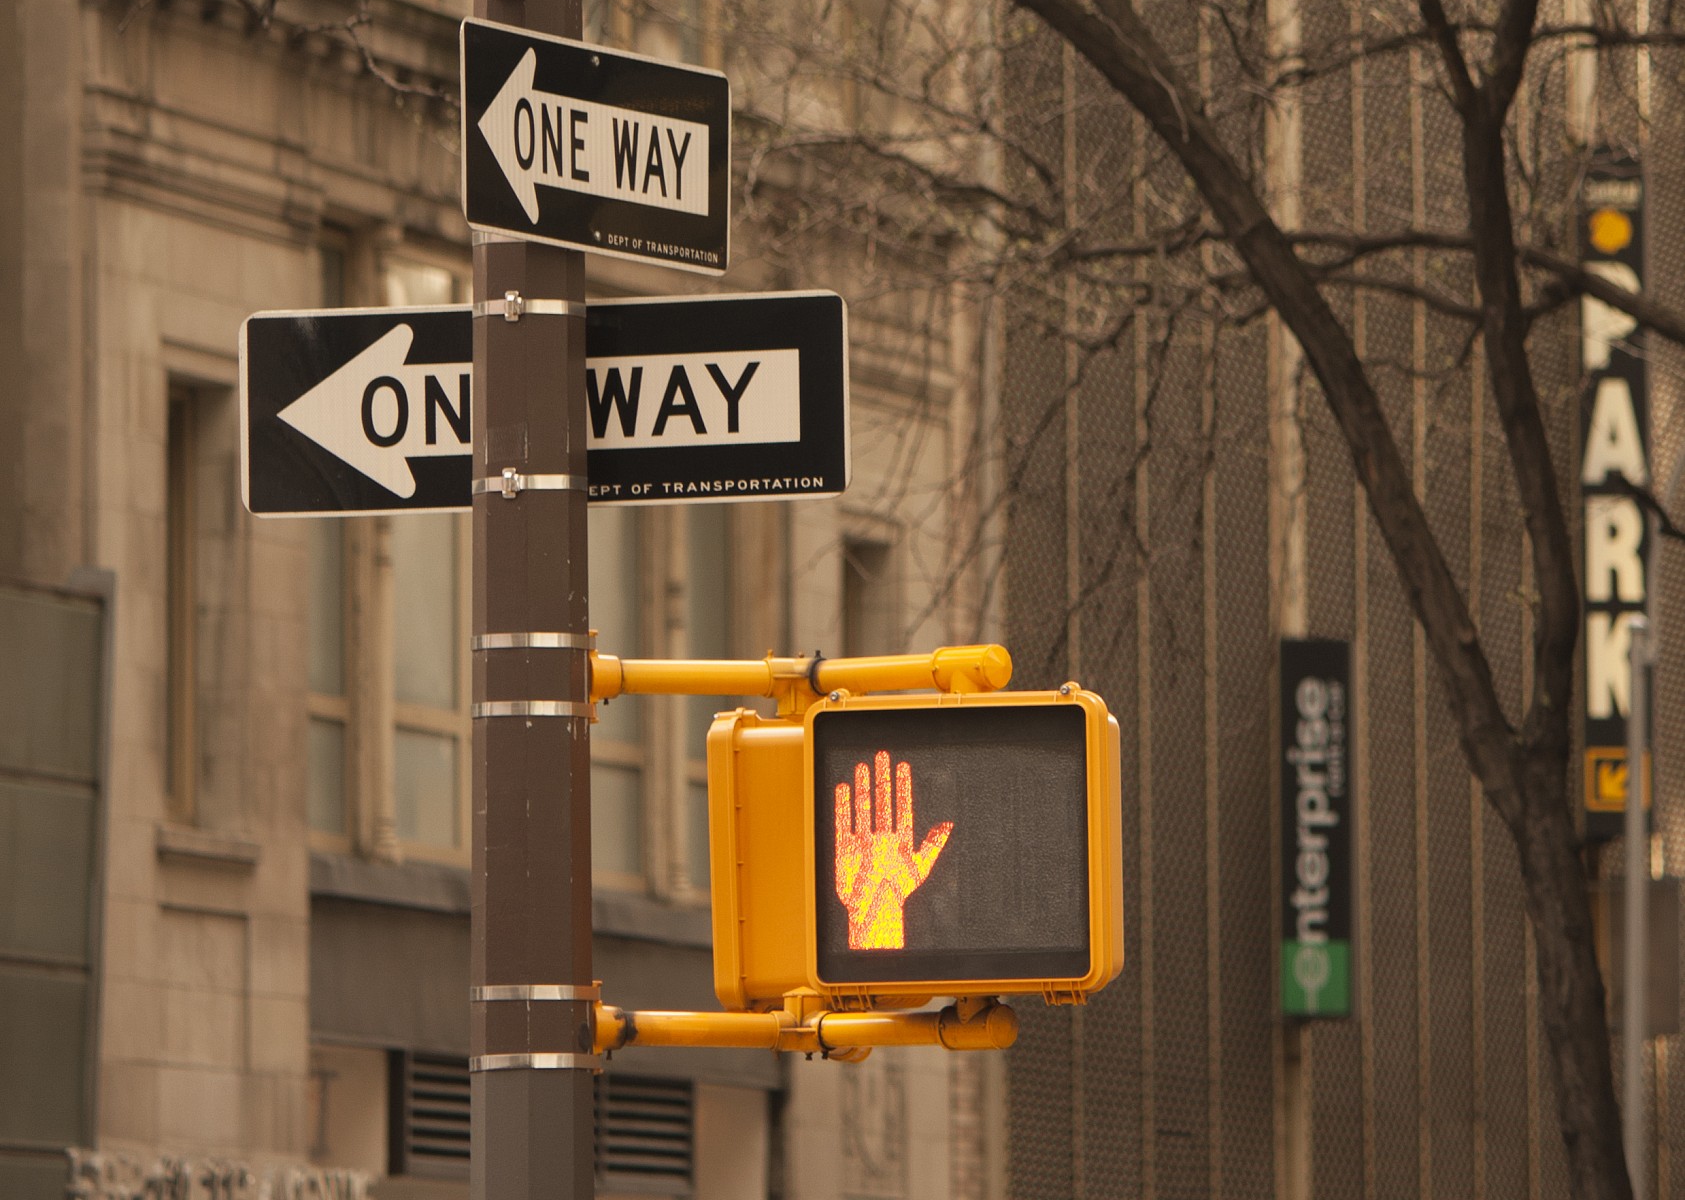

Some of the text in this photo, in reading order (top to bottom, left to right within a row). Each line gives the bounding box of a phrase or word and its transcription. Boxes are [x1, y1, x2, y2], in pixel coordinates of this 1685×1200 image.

[514, 97, 691, 200] ONE WAY
[607, 233, 719, 264] DEPT OF TRANSPORTATION
[361, 361, 761, 448] ON WAY
[588, 477, 824, 496] EPT OF TRANSPORTATION
[1580, 260, 1648, 719] PARK
[1286, 676, 1339, 998] enterprise
